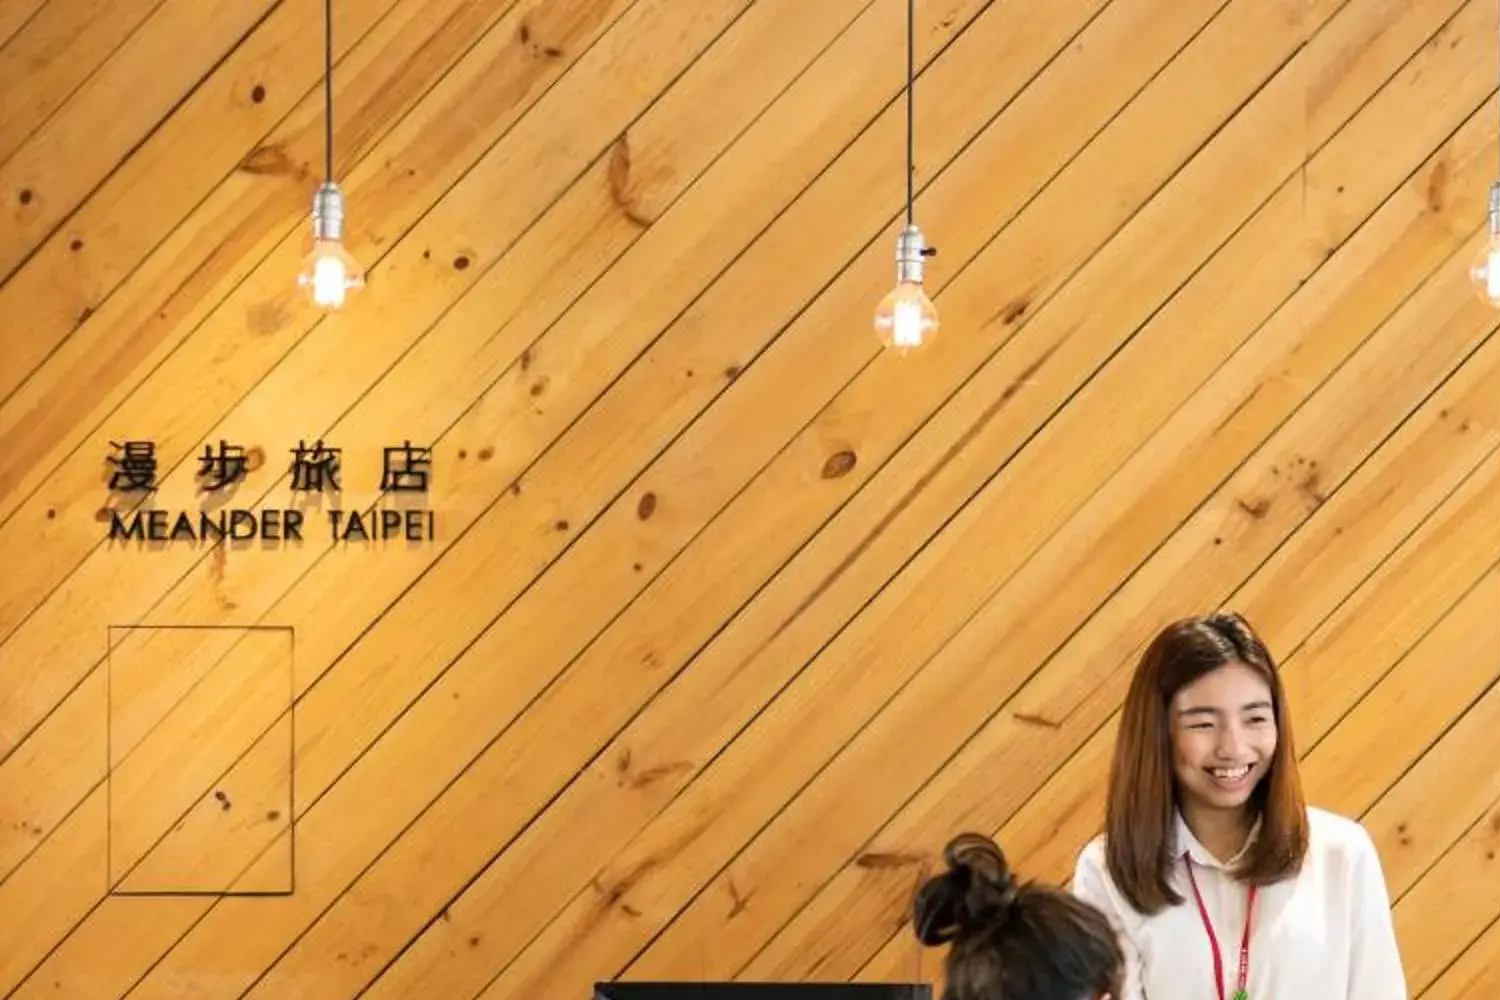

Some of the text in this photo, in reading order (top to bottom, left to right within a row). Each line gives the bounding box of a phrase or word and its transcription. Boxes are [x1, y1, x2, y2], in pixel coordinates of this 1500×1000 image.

[106, 439, 433, 493] 漫步旅店
[107, 509, 435, 541] MEANDER TAIPEI
